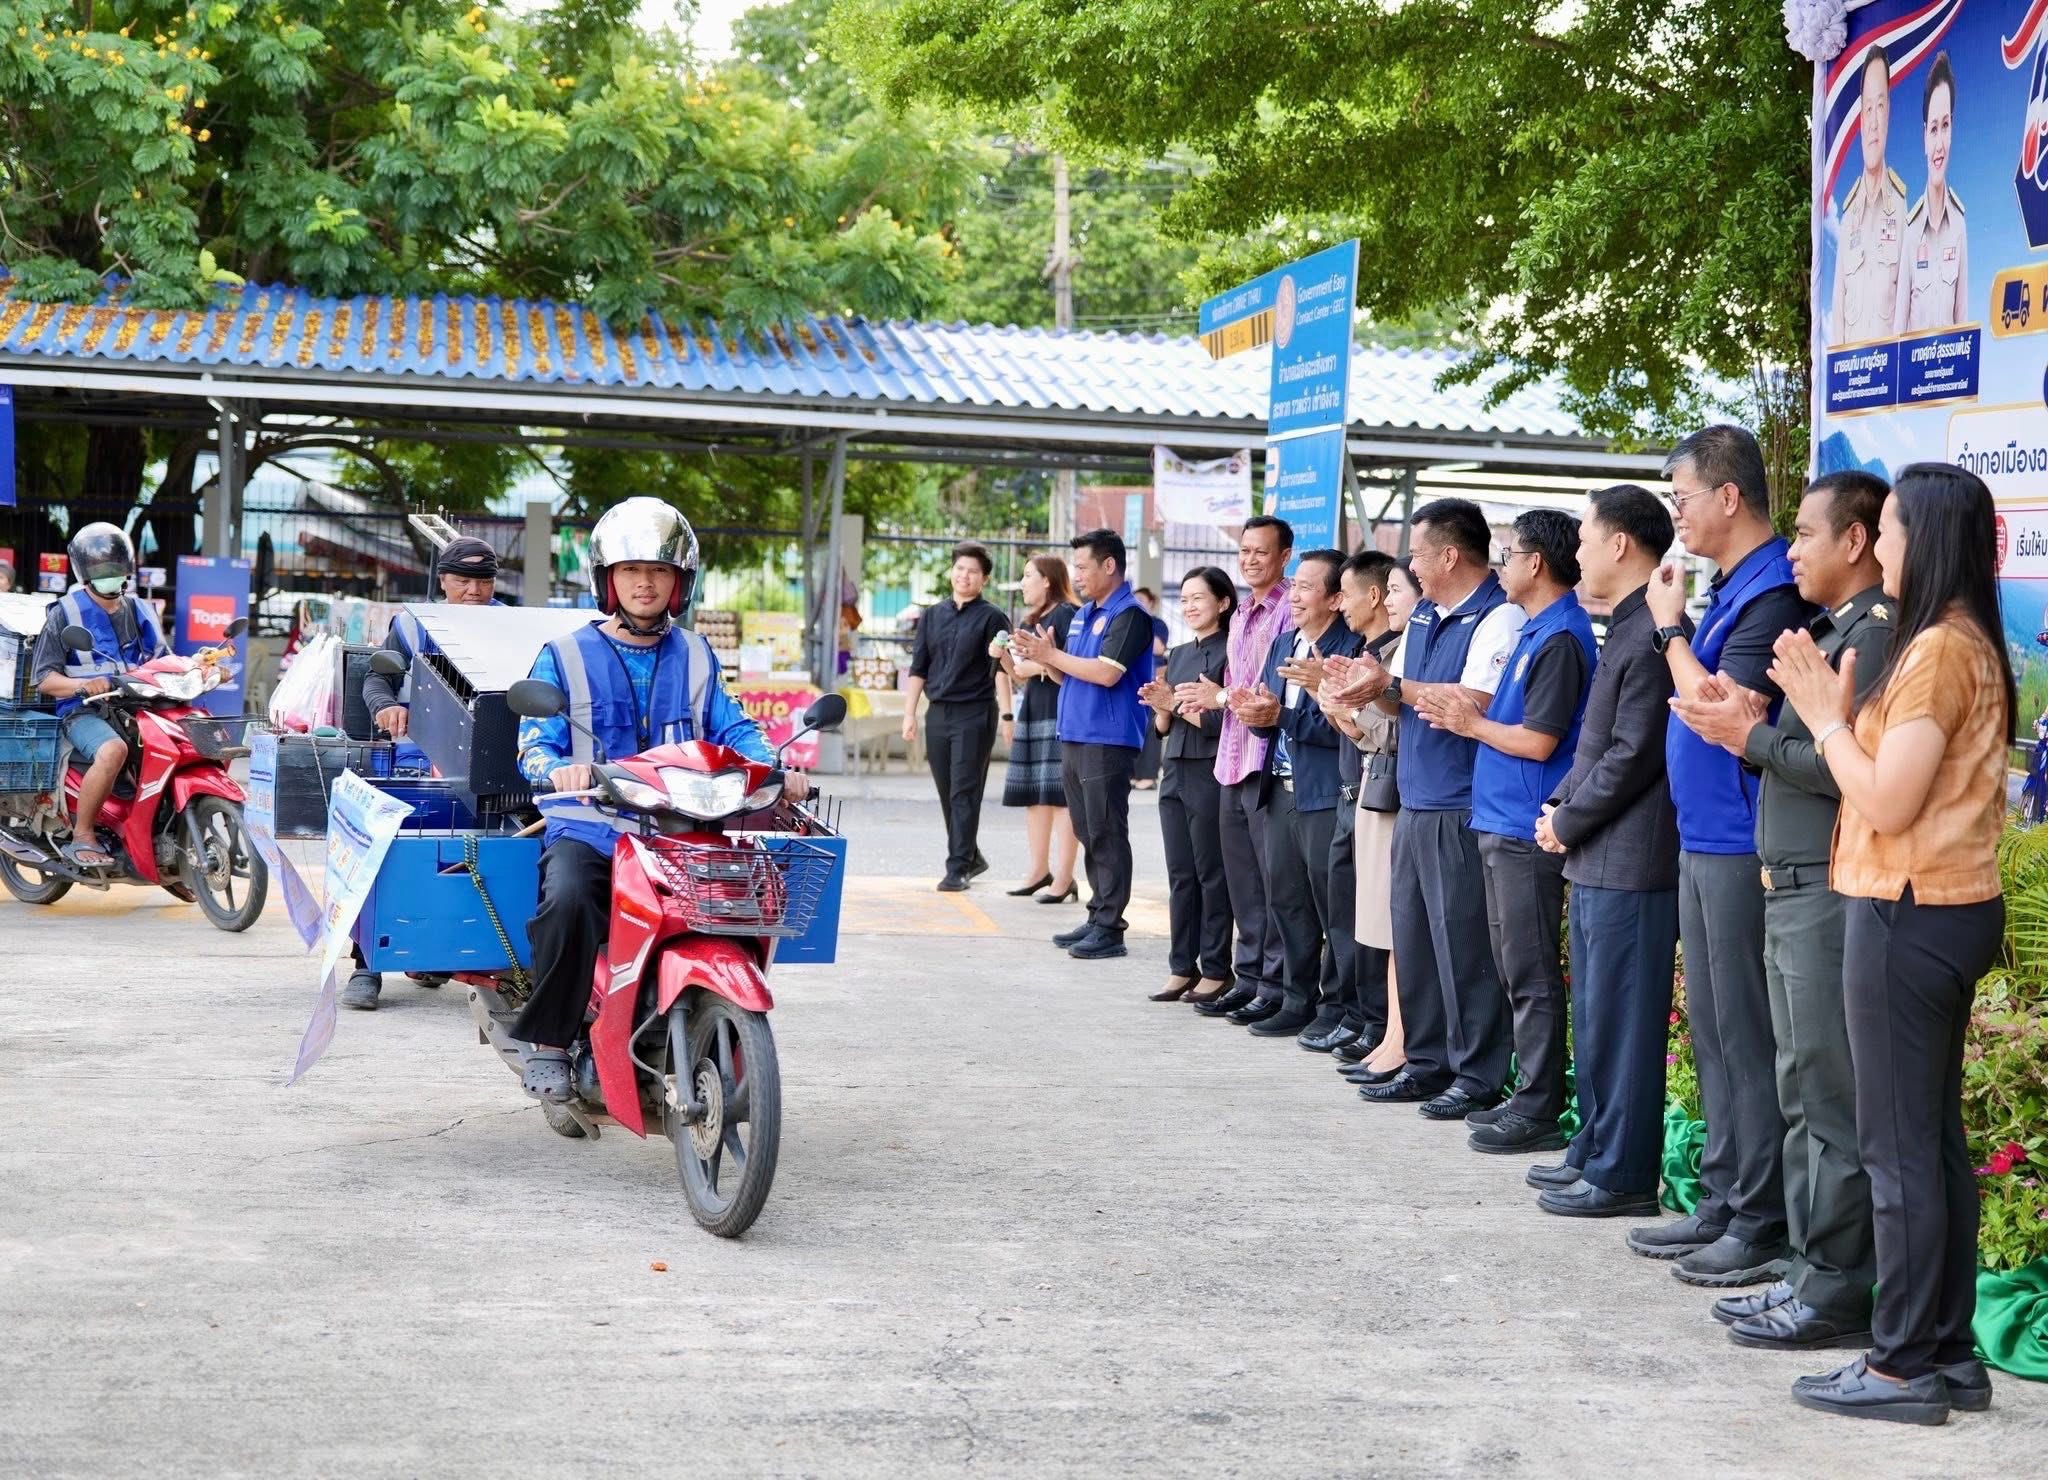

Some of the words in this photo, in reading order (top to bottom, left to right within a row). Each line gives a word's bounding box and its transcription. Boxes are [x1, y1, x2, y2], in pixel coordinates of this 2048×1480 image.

[1298, 274, 1334, 304] Government
[1333, 273, 1346, 294] Easy
[191, 609, 233, 628] Tops
[620, 911, 650, 930] HONDA
